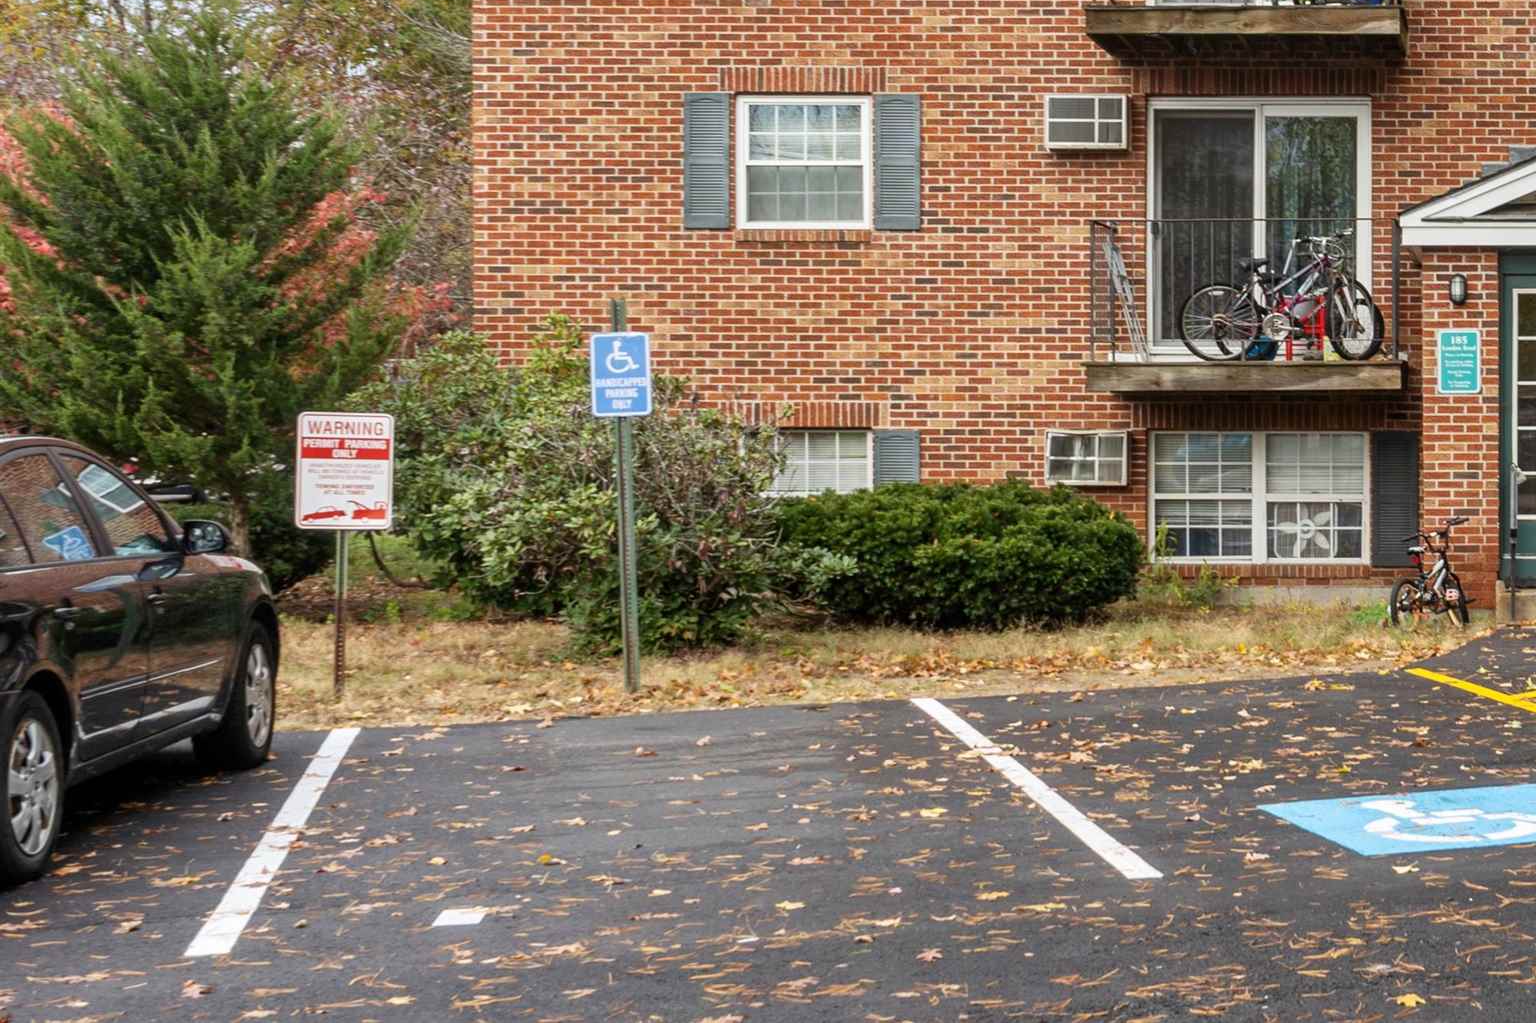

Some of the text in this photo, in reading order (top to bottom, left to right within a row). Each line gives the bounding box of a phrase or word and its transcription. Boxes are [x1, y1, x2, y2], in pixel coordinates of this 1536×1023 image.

[1451, 335, 1468, 345] 185
[605, 387, 639, 398] PARKING
[612, 399, 632, 409] ONLY
[308, 420, 384, 436] WARNING
[303, 438, 387, 450] PERMIT PARKING
[332, 449, 357, 458] ONLY
